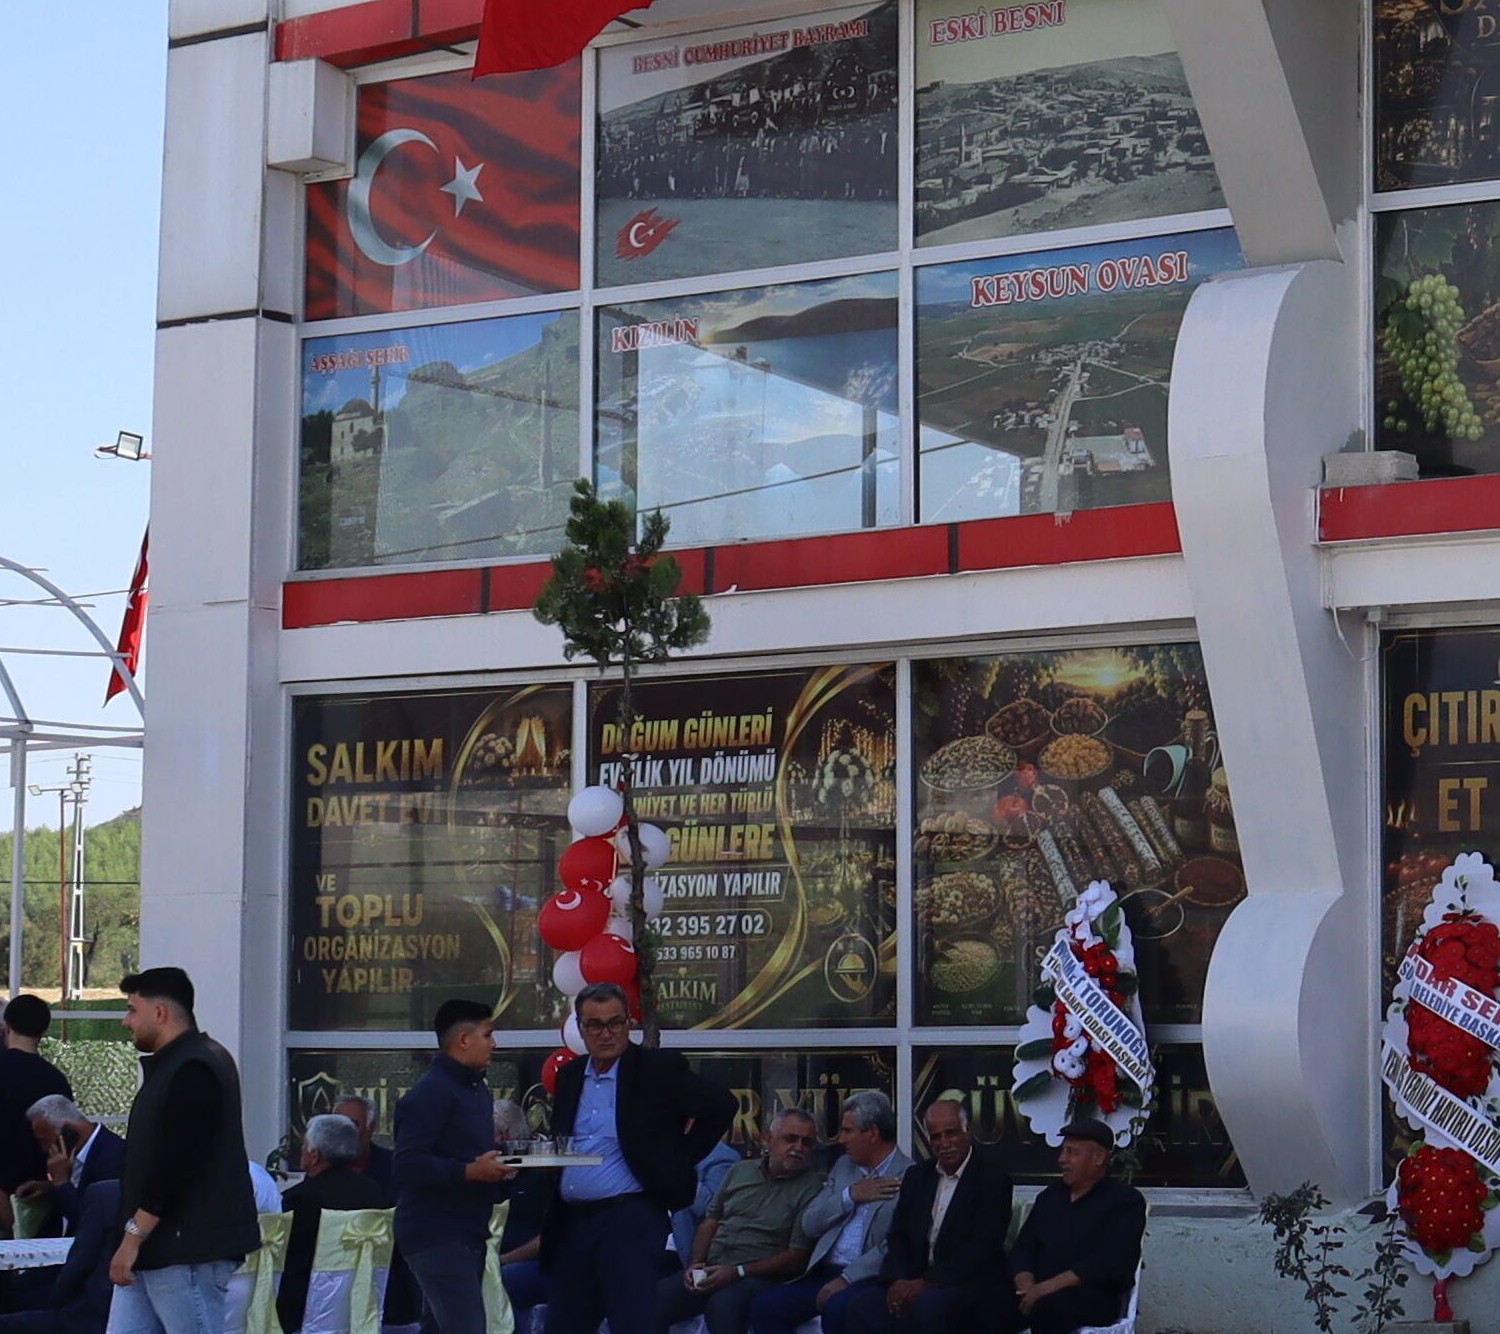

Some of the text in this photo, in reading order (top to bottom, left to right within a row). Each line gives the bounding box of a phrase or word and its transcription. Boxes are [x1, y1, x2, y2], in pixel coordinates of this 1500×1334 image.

[929, 8, 986, 46] ESKİ
[632, 19, 869, 74] BESNİ CUMHURİYET BAYRAMI
[971, 250, 1189, 308] KEYSUN OVASI
[683, 706, 773, 749] GÜNLERİ
[306, 738, 444, 787] SALKIM
[668, 748, 776, 787] YIL DÖNÜMÜ
[307, 784, 442, 828] DAVET EVİ
[680, 788, 773, 815] VE HER TÜRLÜ
[1438, 777, 1488, 832] ET
[315, 873, 336, 892] VE
[721, 871, 781, 897] YAPILIR
[315, 893, 424, 928] TOPLU
[676, 915, 711, 936] 395
[715, 915, 738, 935] 27
[741, 914, 765, 934] 02
[304, 929, 461, 961] ORGANİZASYON
[656, 944, 737, 961] 533 965 10 87
[322, 967, 414, 993] YAPILIR
[657, 979, 717, 1005] ALKIM
[1412, 983, 1460, 1022] BELEDİYE
